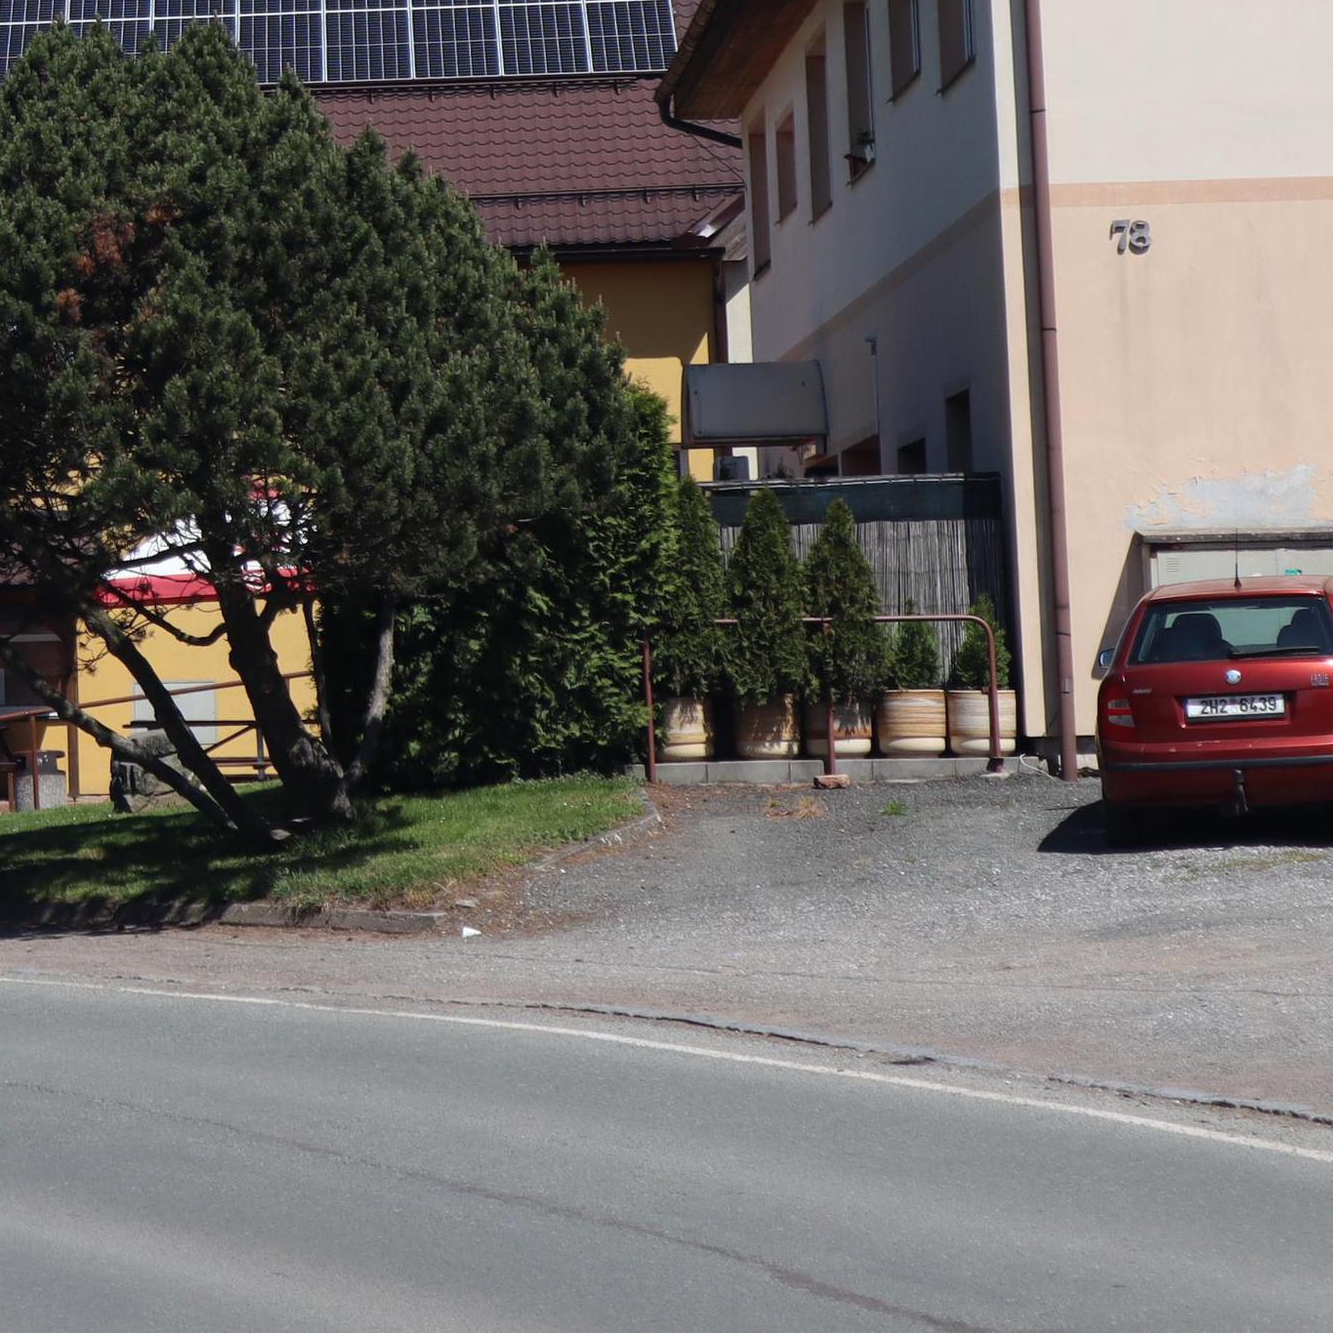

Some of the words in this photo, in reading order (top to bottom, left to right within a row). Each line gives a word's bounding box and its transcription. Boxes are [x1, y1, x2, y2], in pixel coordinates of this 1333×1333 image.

[1109, 219, 1152, 255] 78
[1201, 699, 1228, 715] 2H2
[1239, 696, 1277, 712] 6439
